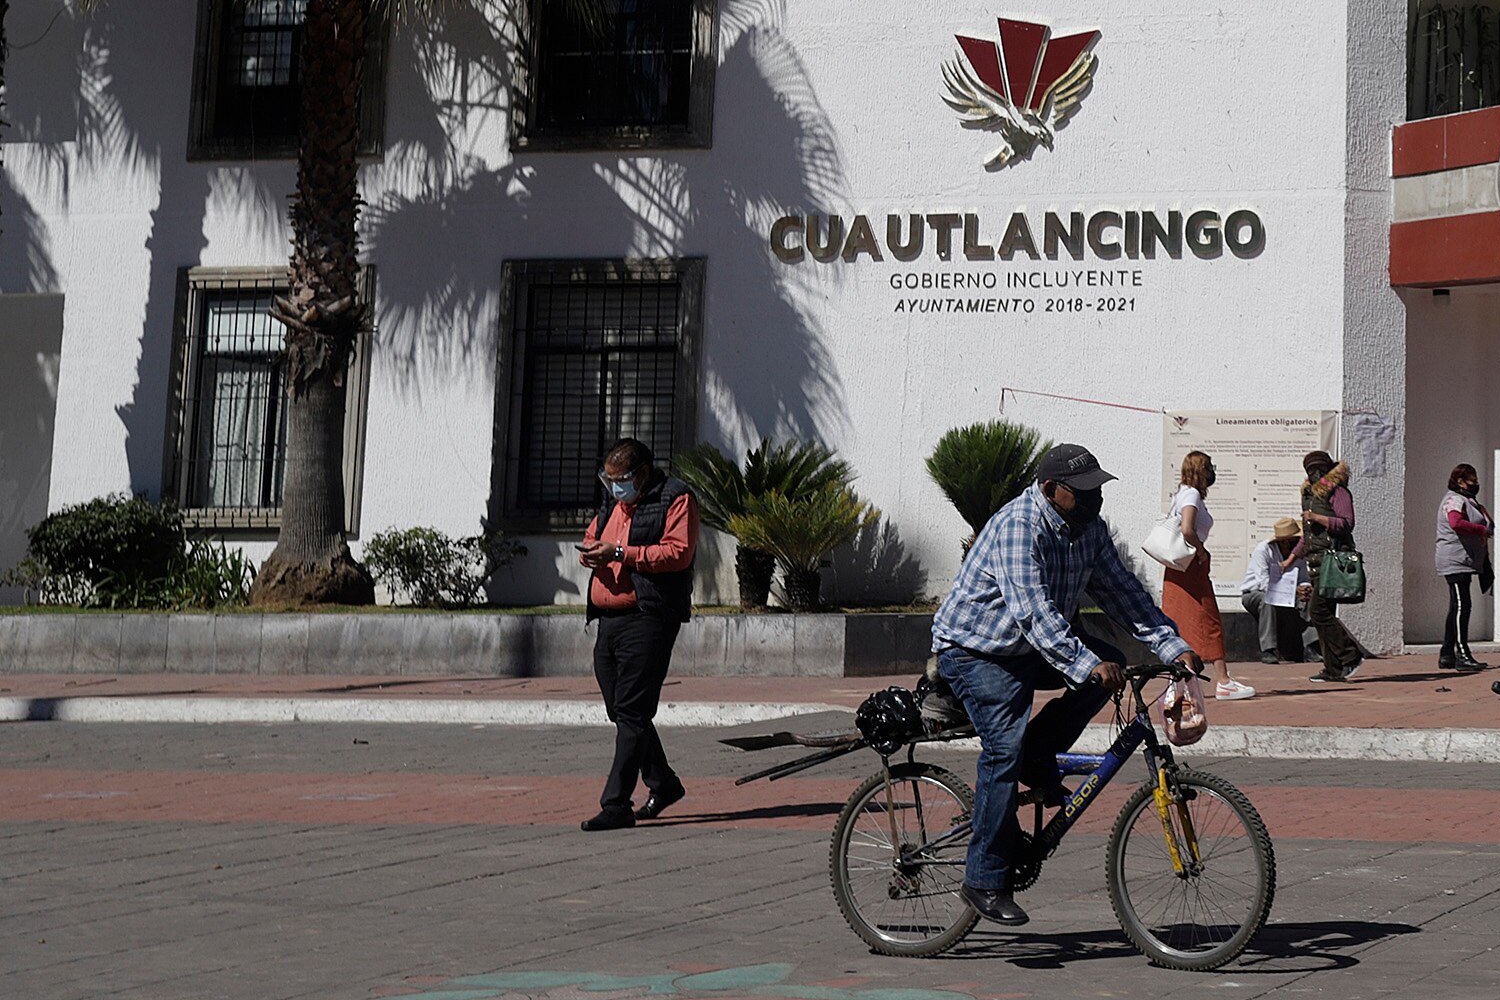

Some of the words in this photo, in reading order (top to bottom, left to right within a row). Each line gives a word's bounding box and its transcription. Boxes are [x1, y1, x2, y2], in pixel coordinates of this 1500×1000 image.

[770, 207, 1267, 264] CUAUTLANCINGO
[889, 271, 997, 290] GOBIERNO
[1005, 269, 1143, 288] INCLUYENTE
[894, 297, 1035, 313] AYUNTAMIENTO
[1044, 296, 1136, 313] 2018-2021
[1216, 418, 1269, 426] Lineamientos
[1270, 417, 1318, 427] obligatorios
